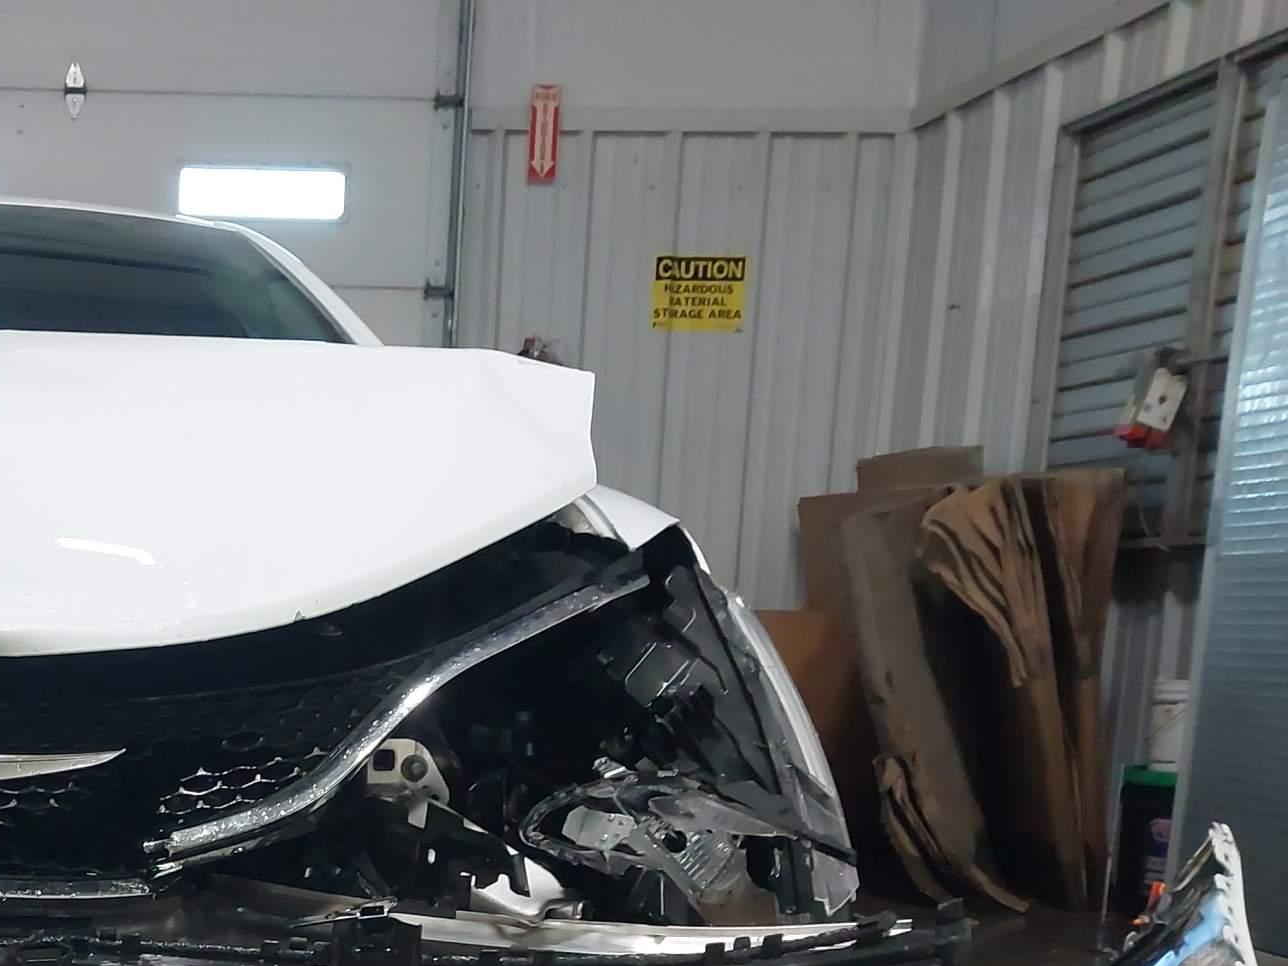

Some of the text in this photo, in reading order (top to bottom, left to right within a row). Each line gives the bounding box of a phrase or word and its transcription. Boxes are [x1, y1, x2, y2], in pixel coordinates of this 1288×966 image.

[658, 259, 743, 279] CAUTION
[664, 283, 733, 294] HZARDOUS
[708, 309, 741, 319] AREA
